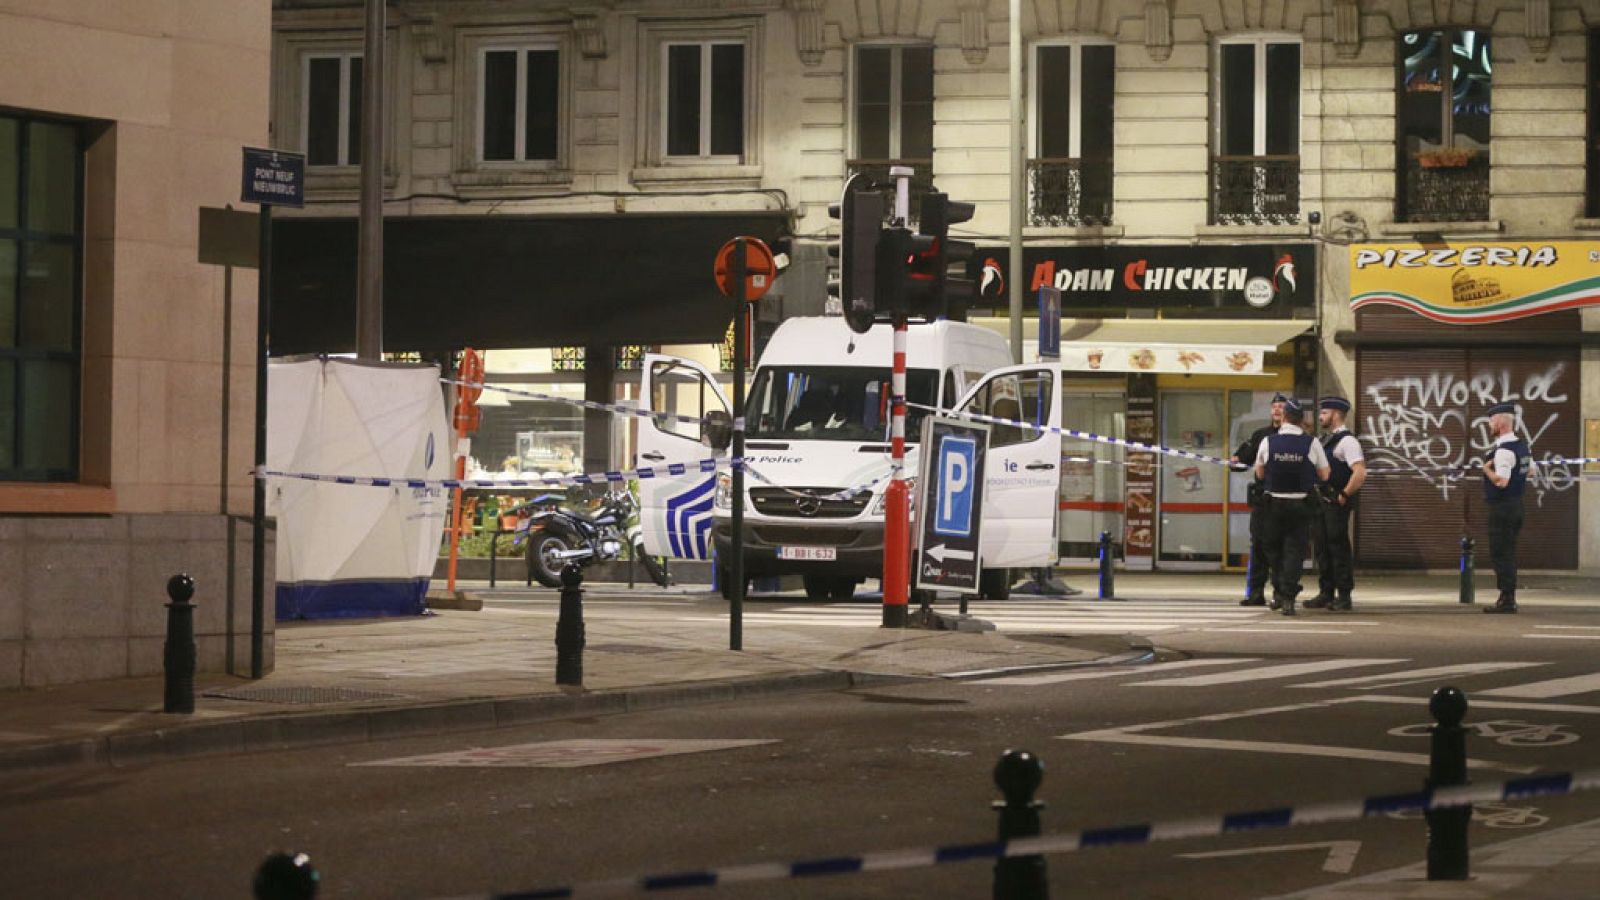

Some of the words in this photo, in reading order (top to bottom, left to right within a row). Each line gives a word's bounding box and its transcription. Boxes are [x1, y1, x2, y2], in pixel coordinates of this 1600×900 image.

[255, 168, 274, 179] PONT
[275, 171, 294, 181] NEUF
[1356, 245, 1558, 268] PIZZERIA
[1031, 259, 1115, 292] ADAM
[1123, 258, 1248, 291] CHICKEN
[759, 454, 804, 464] Police
[1274, 452, 1304, 462] Politie
[943, 451, 968, 521] P
